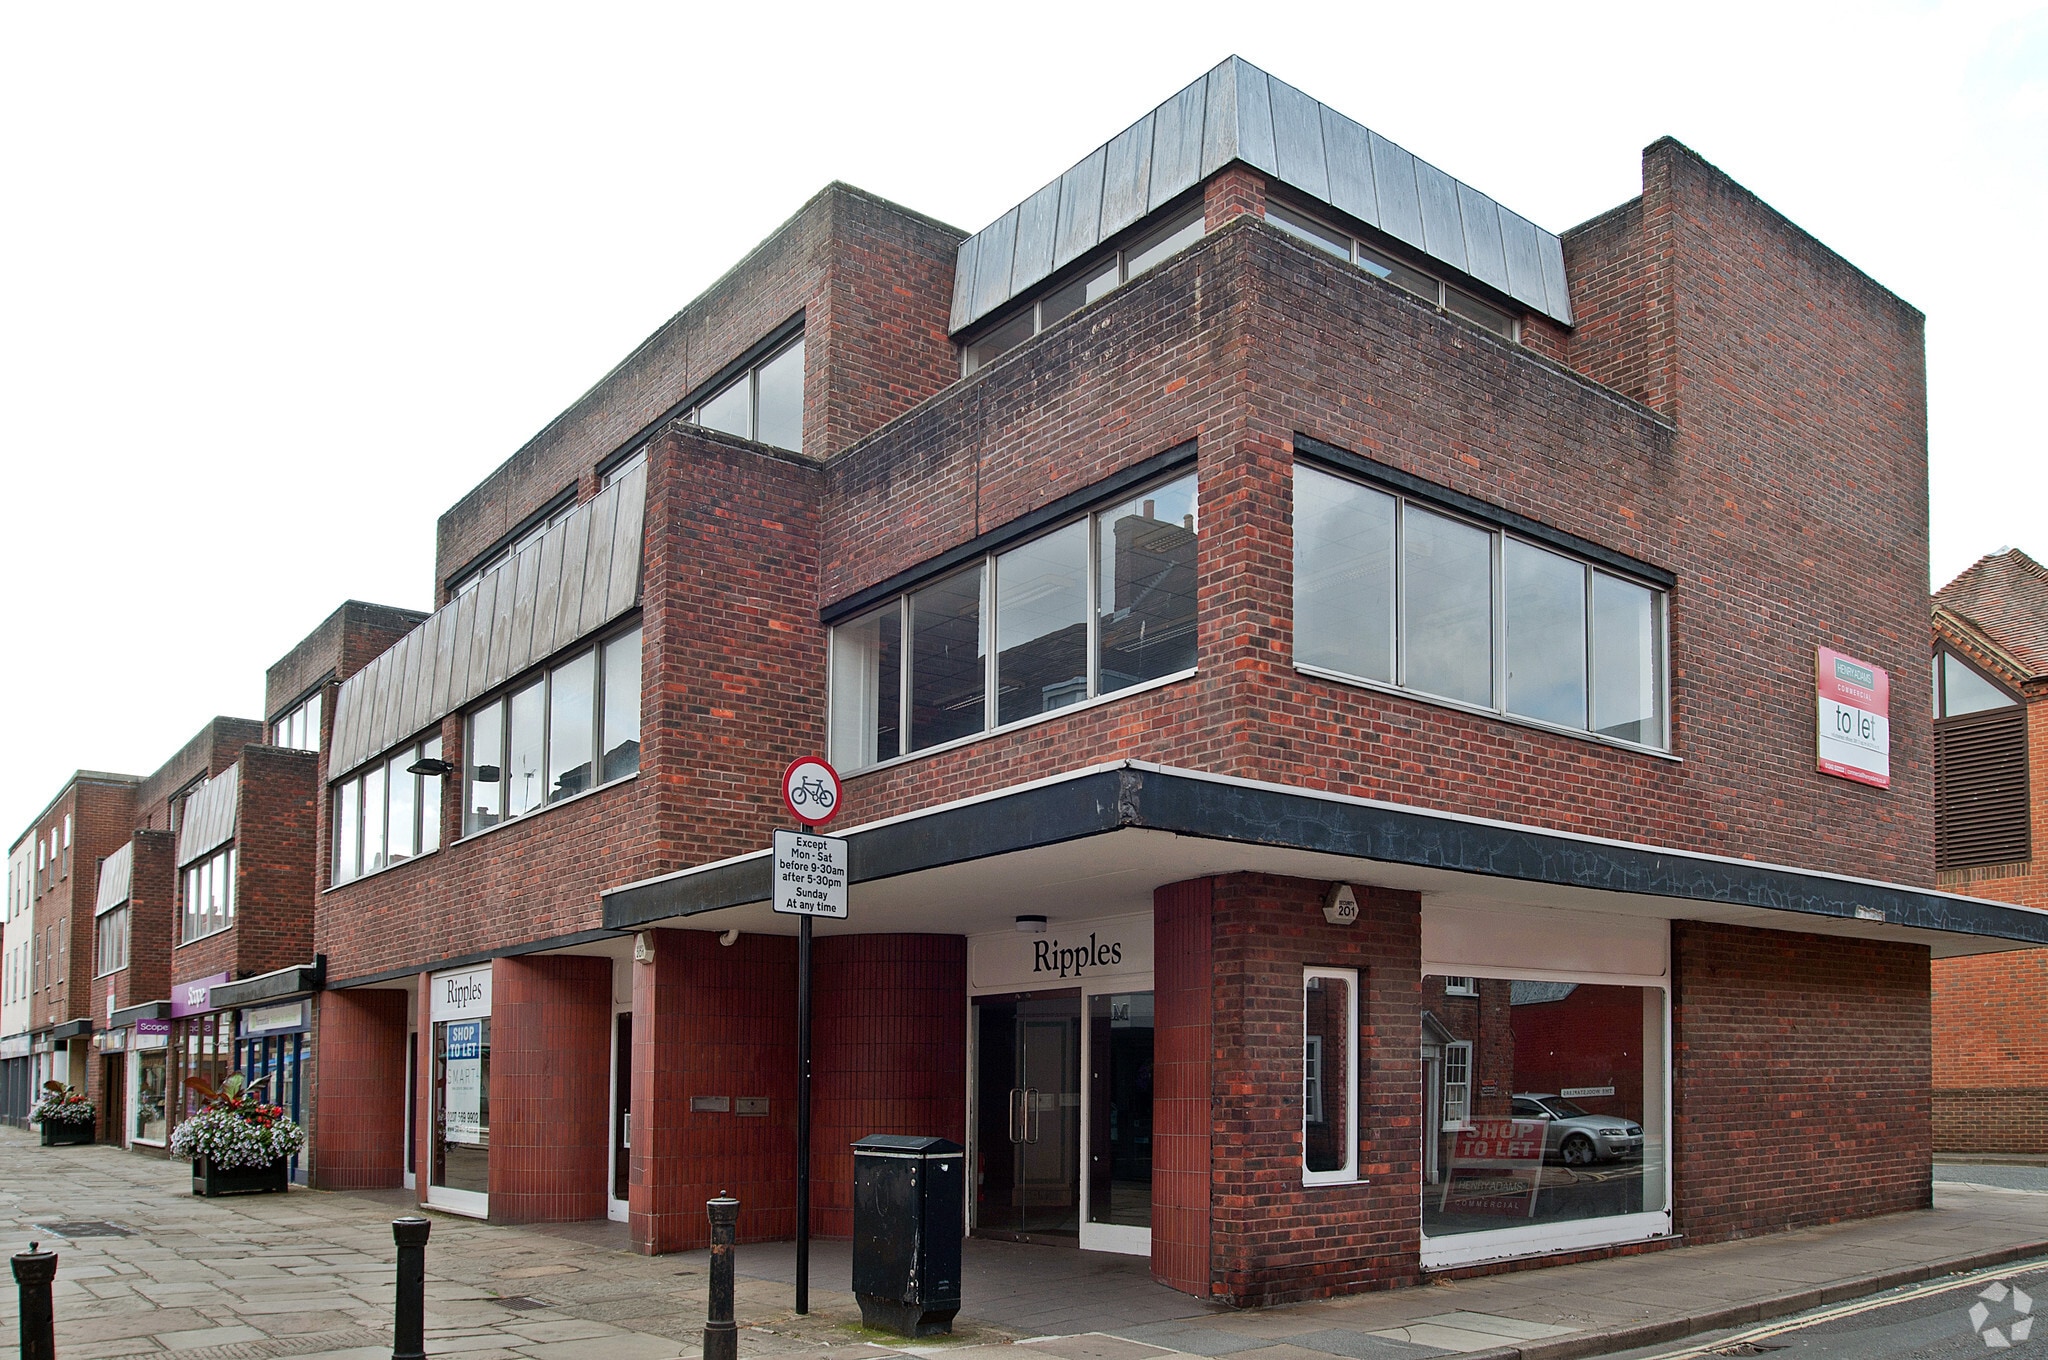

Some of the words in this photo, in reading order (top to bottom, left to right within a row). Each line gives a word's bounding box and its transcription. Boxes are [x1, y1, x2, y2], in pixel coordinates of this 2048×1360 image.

[1838, 684, 1872, 701] COMMERCIAL
[1836, 705, 1851, 733] to
[1858, 709, 1875, 742] let
[797, 837, 828, 851] Except
[791, 848, 810, 860] Mon
[817, 852, 833, 863] Sat
[780, 859, 809, 872] before
[782, 872, 805, 883] after
[796, 887, 828, 901] Sunday
[786, 898, 797, 909] At
[800, 901, 815, 912] any
[817, 901, 837, 912] time
[1339, 905, 1355, 917] 201
[1033, 932, 1122, 978] Ripples
[447, 976, 482, 1008] Ripples
[140, 1022, 169, 1032] Scope
[452, 1026, 474, 1041] SHOP
[450, 1043, 460, 1058] TO
[462, 1042, 477, 1057] LET
[1466, 1123, 1534, 1139] SHOP
[1462, 1141, 1488, 1156] TO
[1496, 1141, 1534, 1157] LET
[1455, 1200, 1519, 1209] COMMERCIAL
